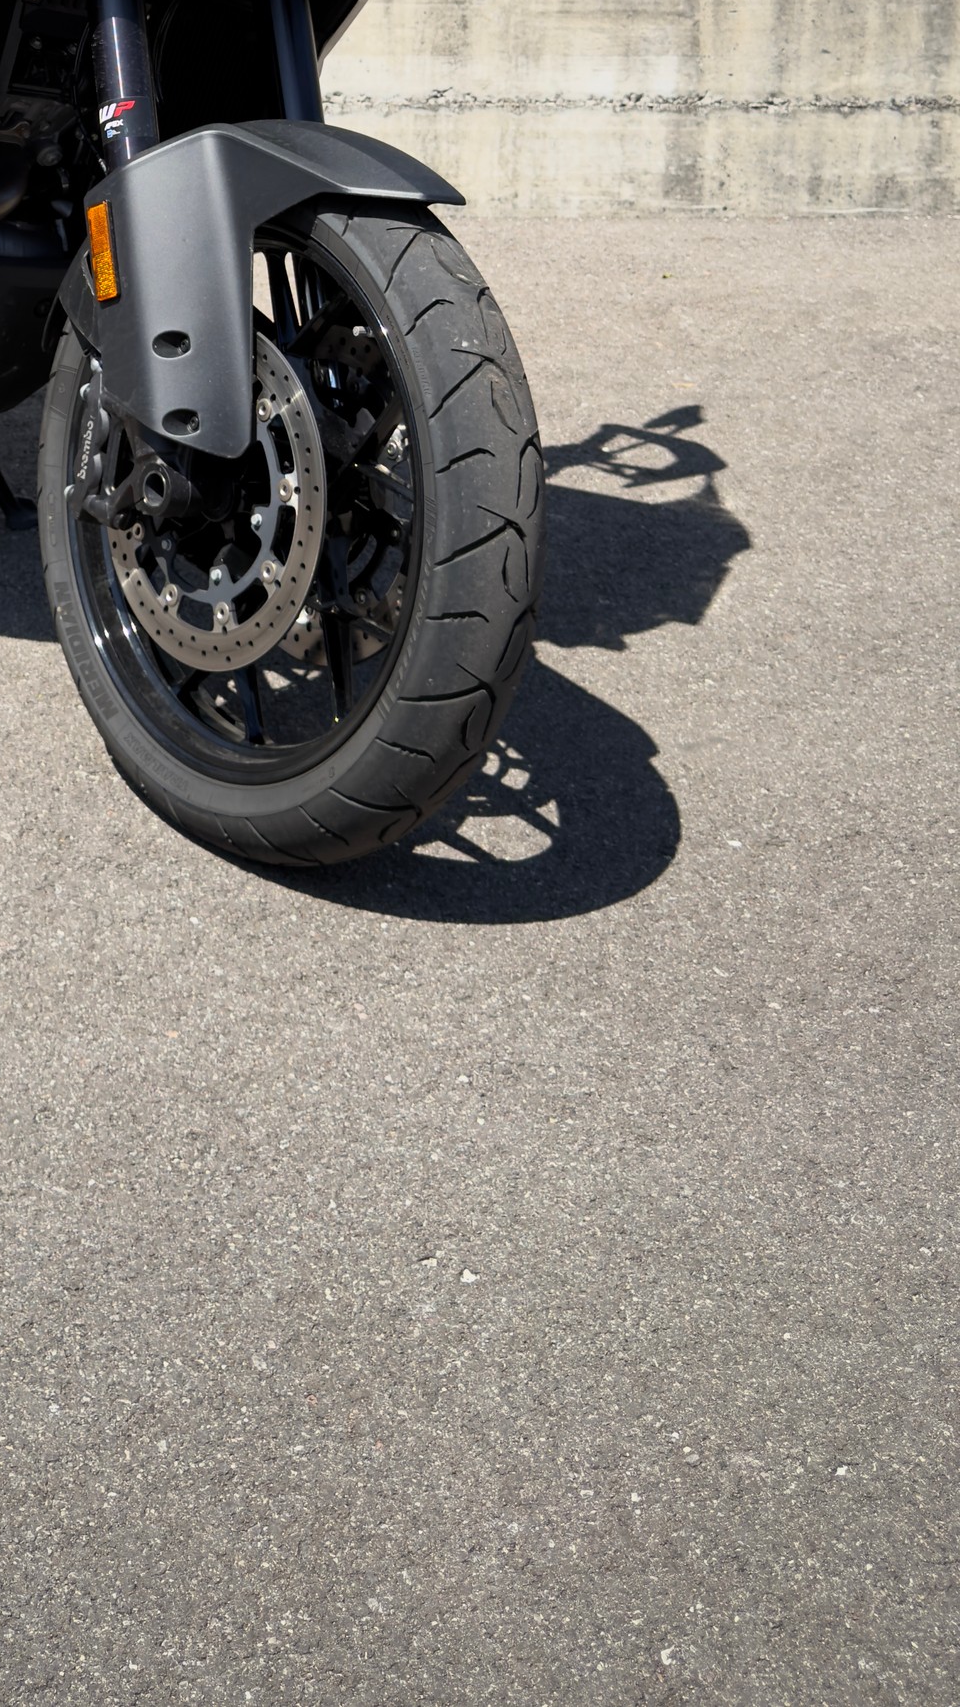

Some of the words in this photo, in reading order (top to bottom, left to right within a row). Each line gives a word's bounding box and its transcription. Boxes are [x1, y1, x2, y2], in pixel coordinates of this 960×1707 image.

[99, 101, 135, 124] WP
[78, 420, 93, 481] brembo
[54, 581, 120, 721] MERIDIAN
